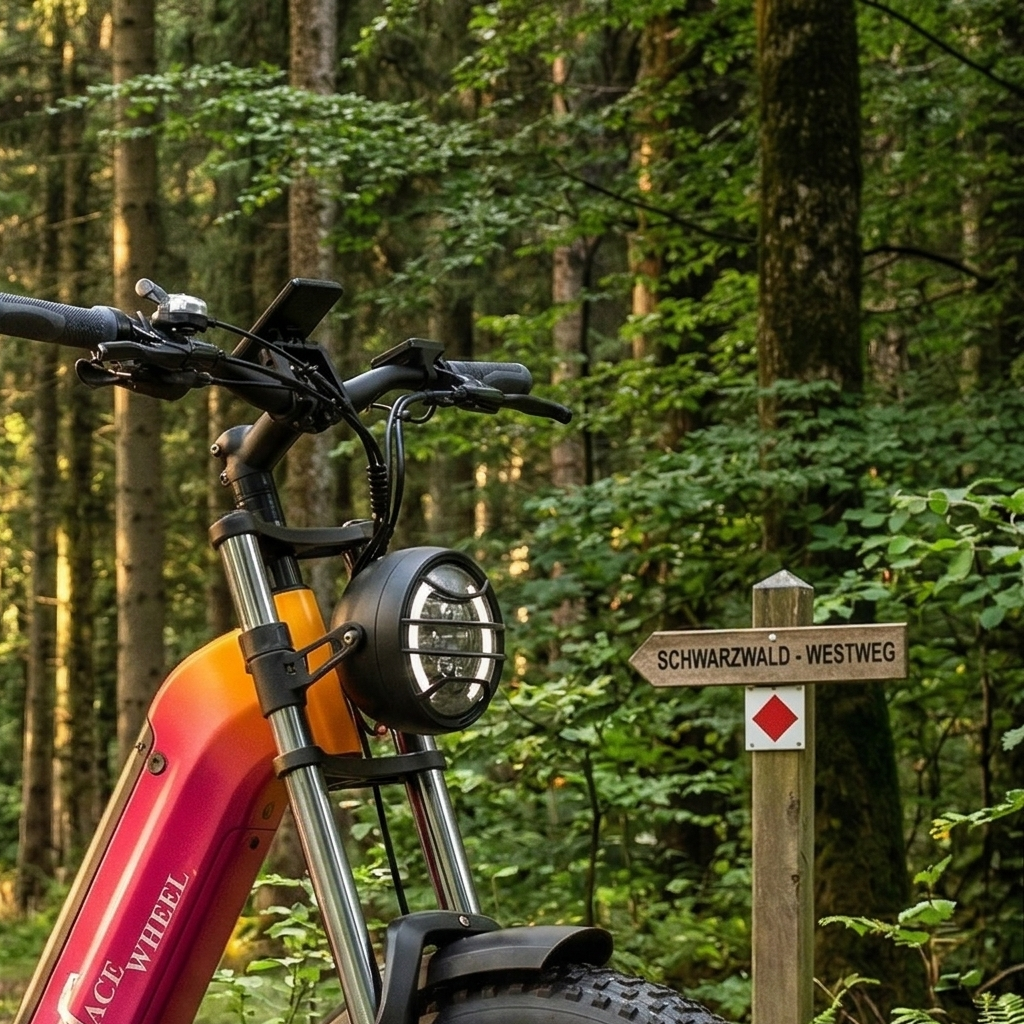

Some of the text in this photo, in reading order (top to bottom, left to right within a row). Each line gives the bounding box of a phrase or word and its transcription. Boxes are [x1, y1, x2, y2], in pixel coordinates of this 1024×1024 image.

[657, 645, 791, 671] SCHWARZWALD
[805, 641, 896, 666] WESTWEG
[125, 872, 190, 974] WHEEL
